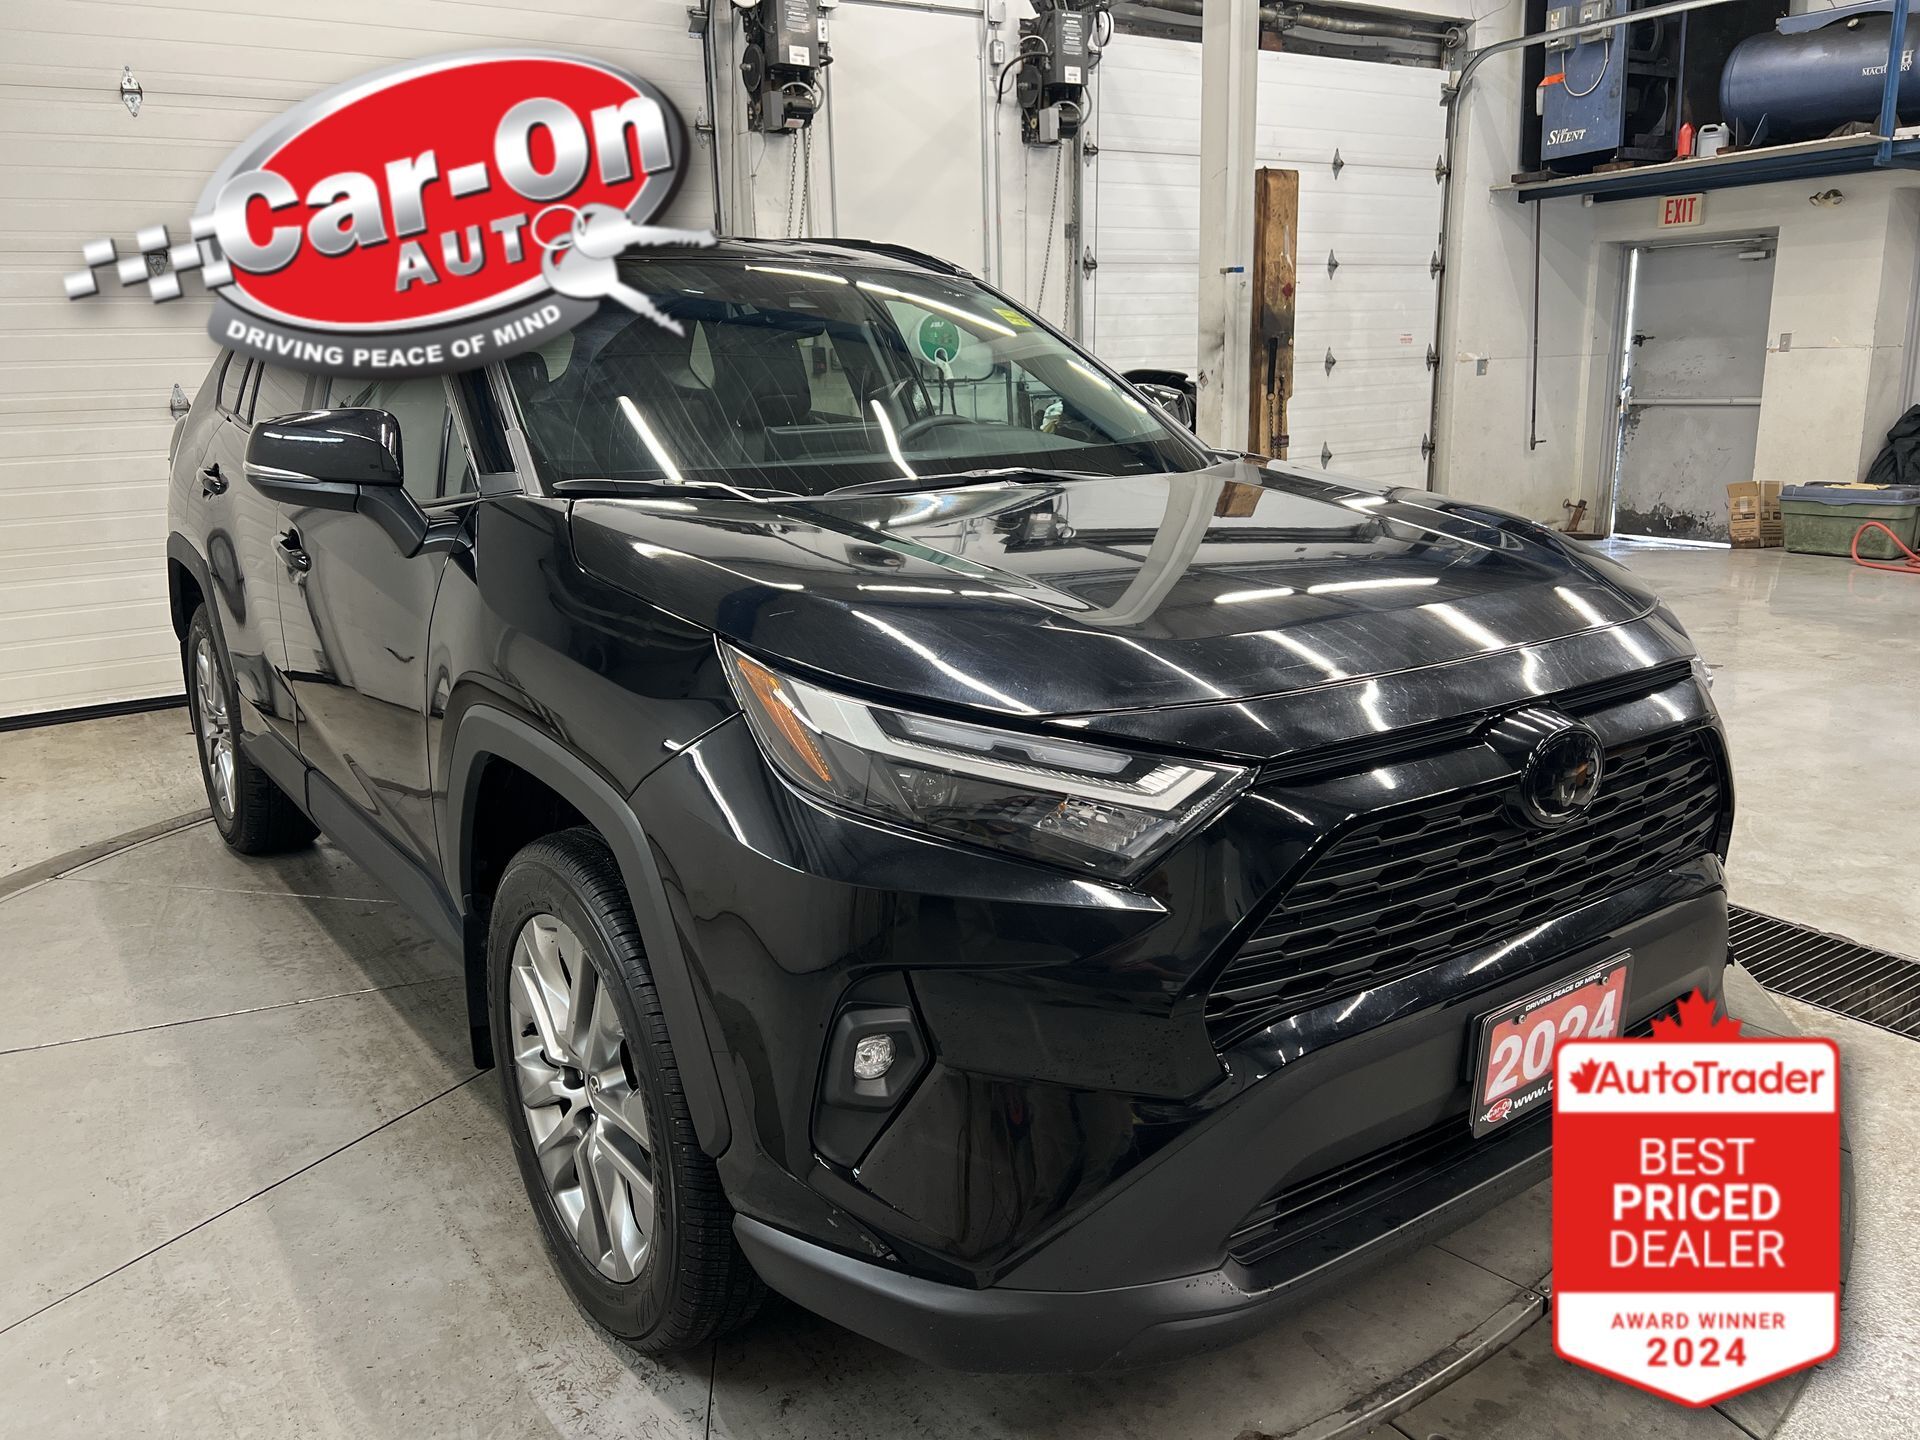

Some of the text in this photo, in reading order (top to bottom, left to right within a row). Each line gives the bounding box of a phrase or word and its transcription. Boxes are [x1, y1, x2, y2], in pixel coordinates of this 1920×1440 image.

[1664, 196, 1697, 225] EXIT
[1525, 971, 1602, 1012] DRIVING PEACE OF MIND
